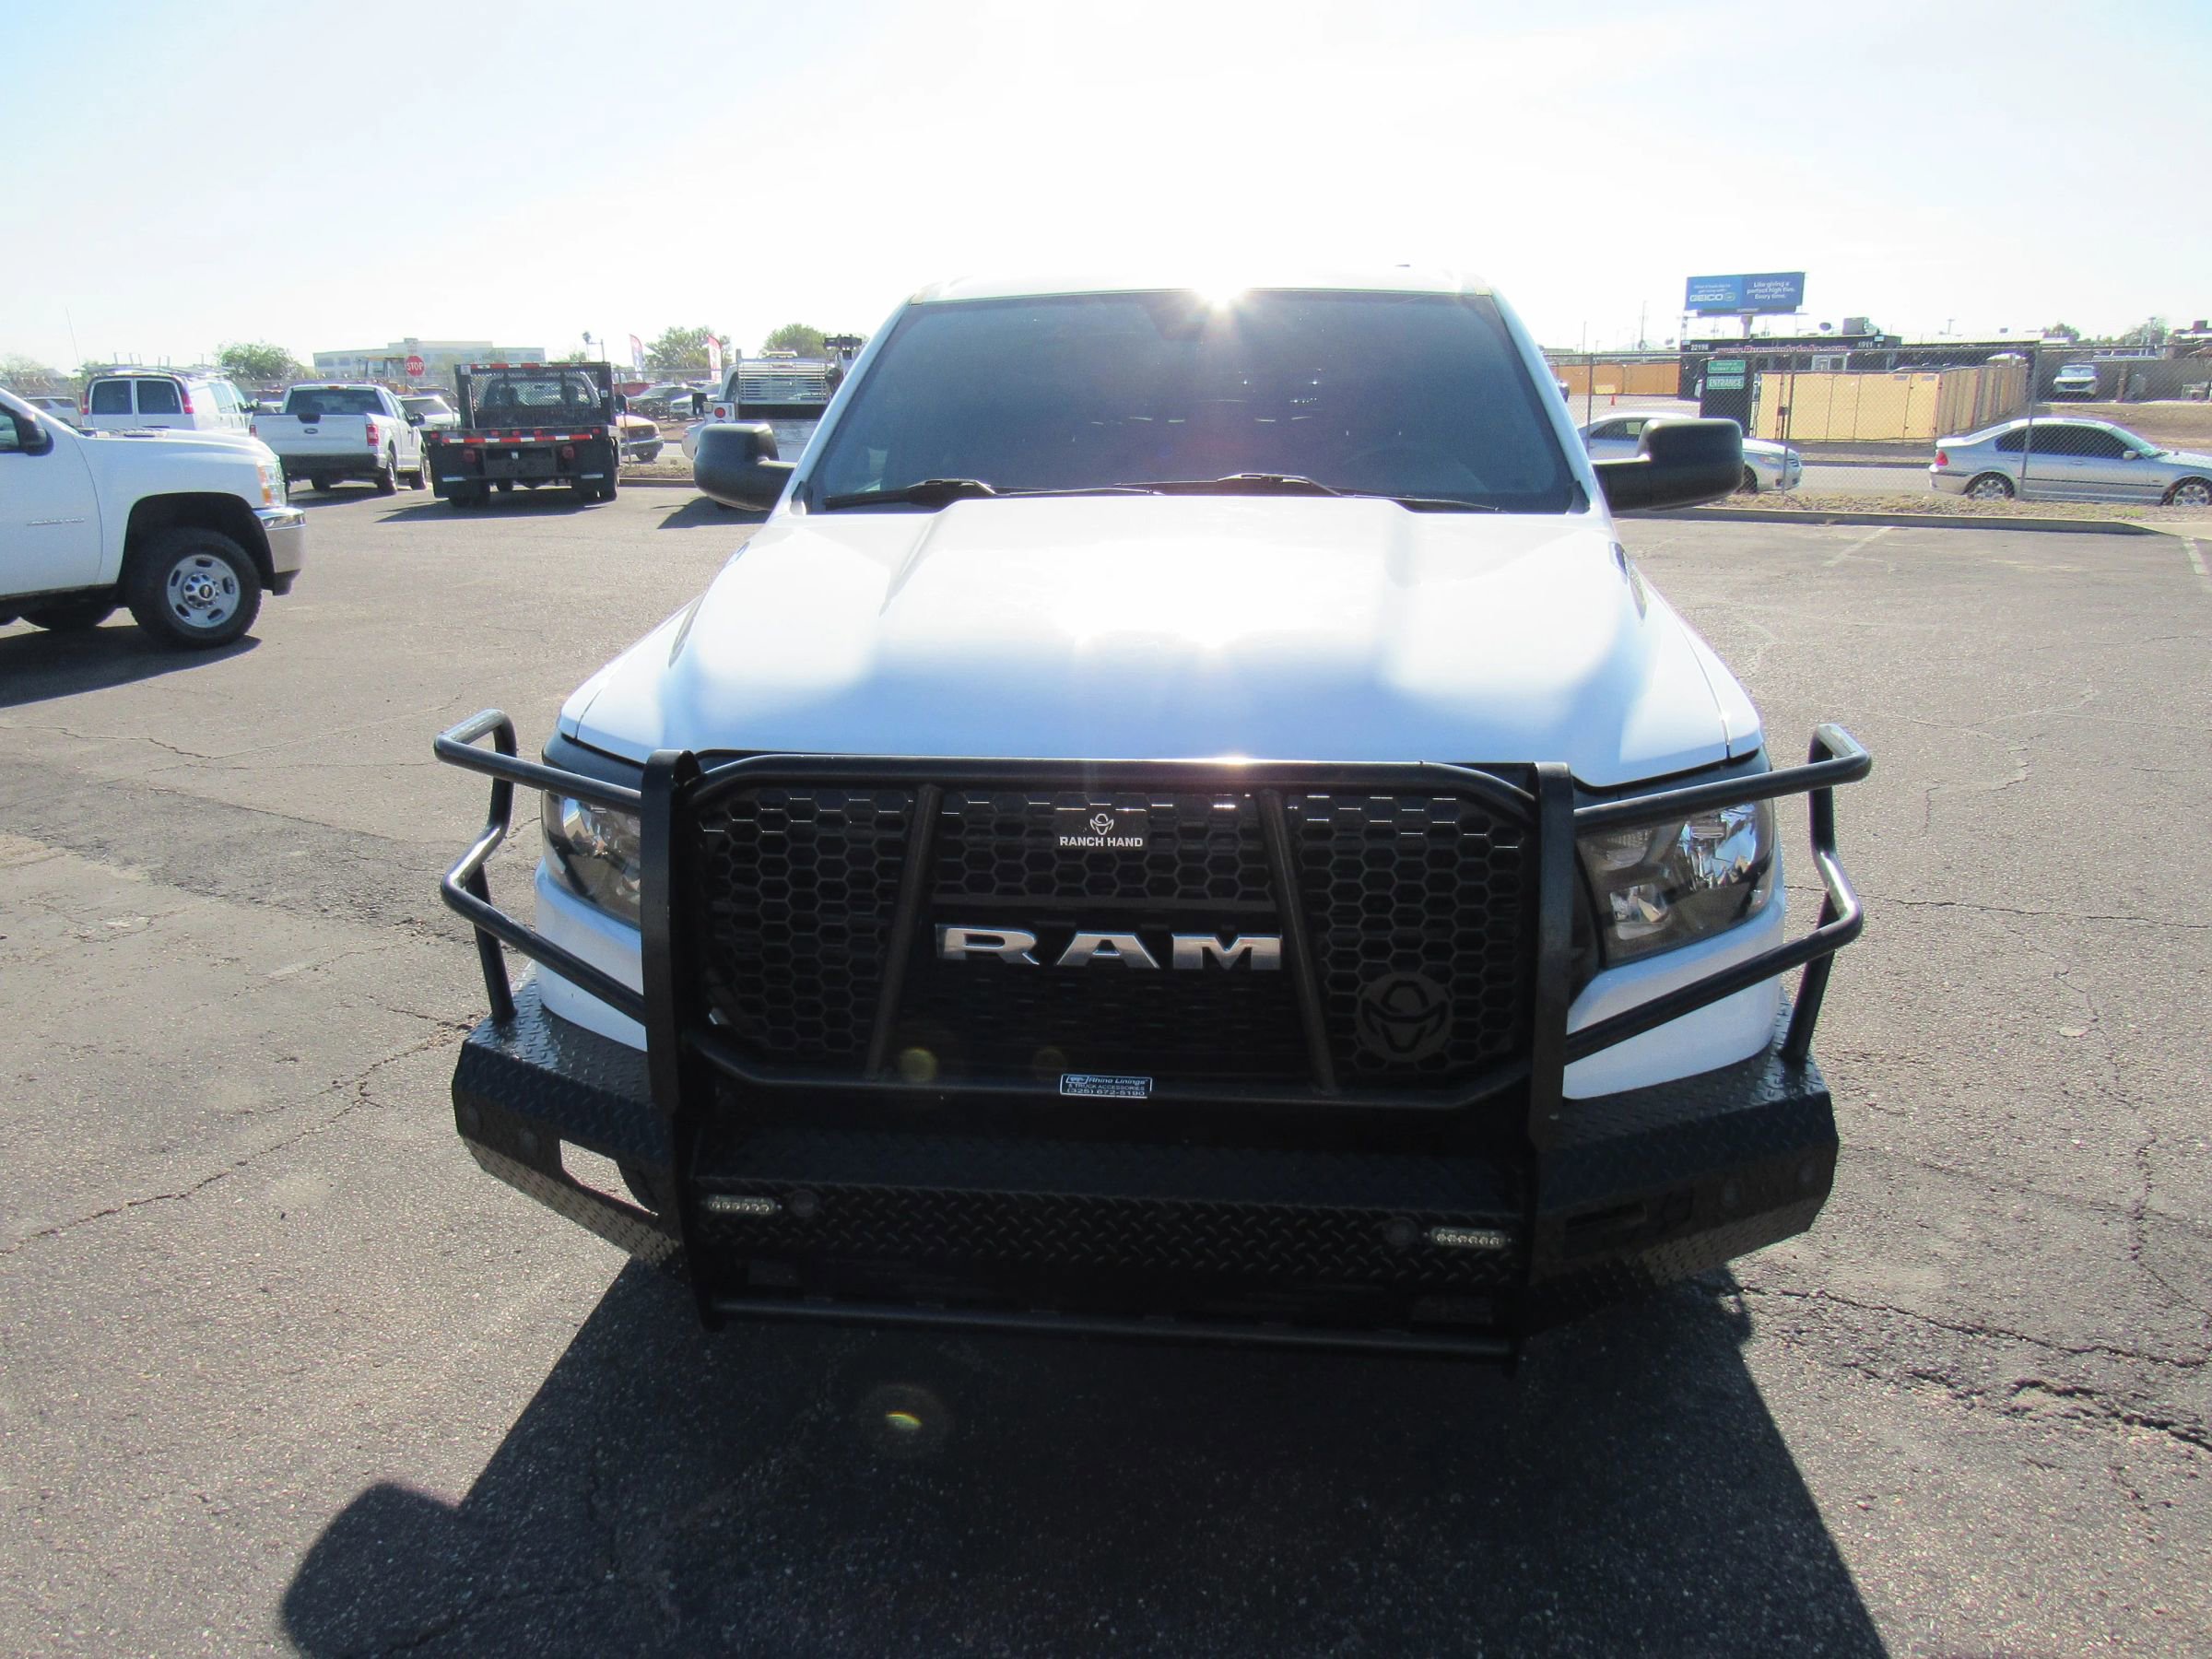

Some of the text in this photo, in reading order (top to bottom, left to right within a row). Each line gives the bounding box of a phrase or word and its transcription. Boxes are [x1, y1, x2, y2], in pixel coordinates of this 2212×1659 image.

[1689, 293, 1724, 302] GEICO
[406, 362, 423, 371] STOP
[1709, 378, 1742, 387] ENTRANCE
[1060, 836, 1143, 847] RANCH HAND
[935, 924, 1283, 971] RAM
